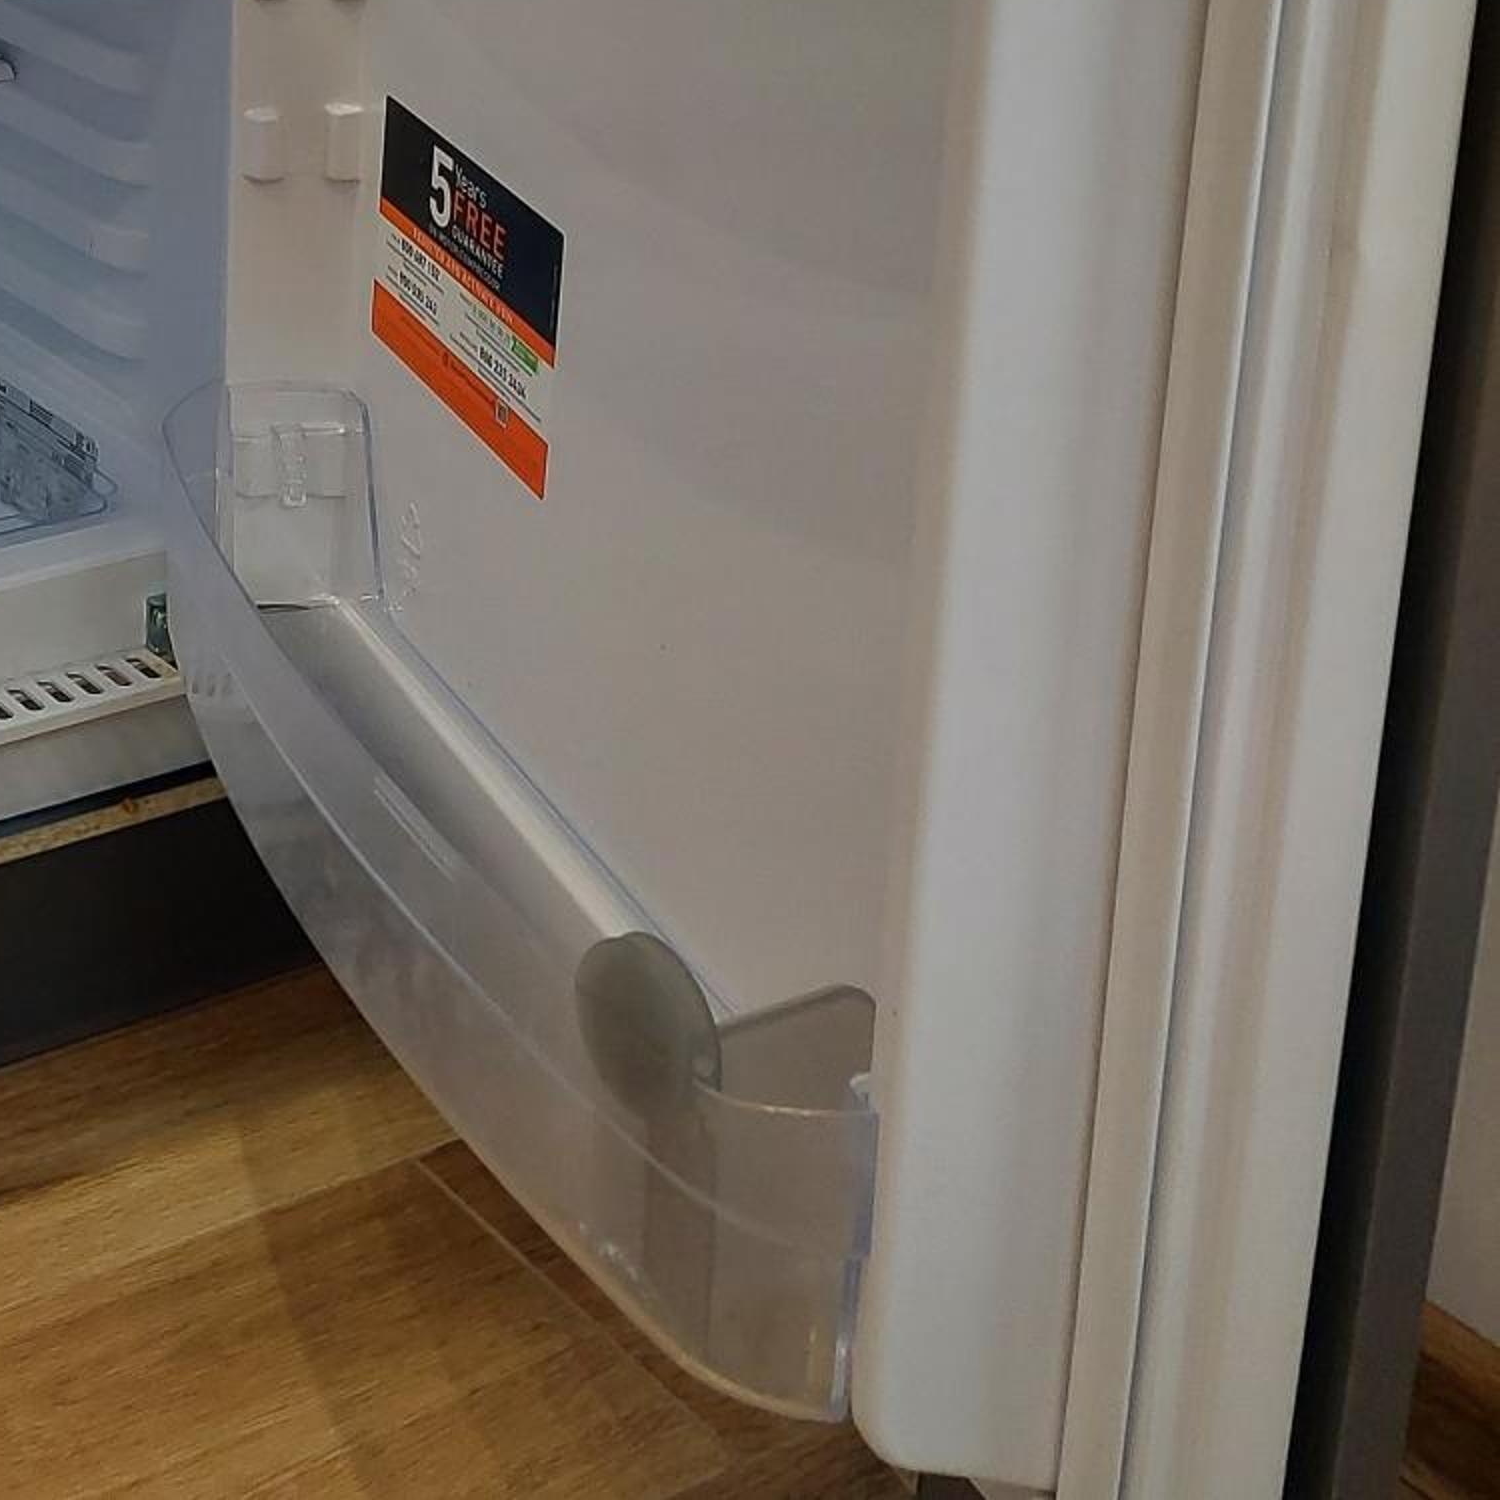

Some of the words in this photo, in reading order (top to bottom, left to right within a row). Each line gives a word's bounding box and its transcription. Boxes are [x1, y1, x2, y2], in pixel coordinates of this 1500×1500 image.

[429, 144, 454, 228] 5
[455, 163, 487, 209] Years
[451, 224, 504, 279] GUARANTEE
[453, 190, 507, 261] FREE
